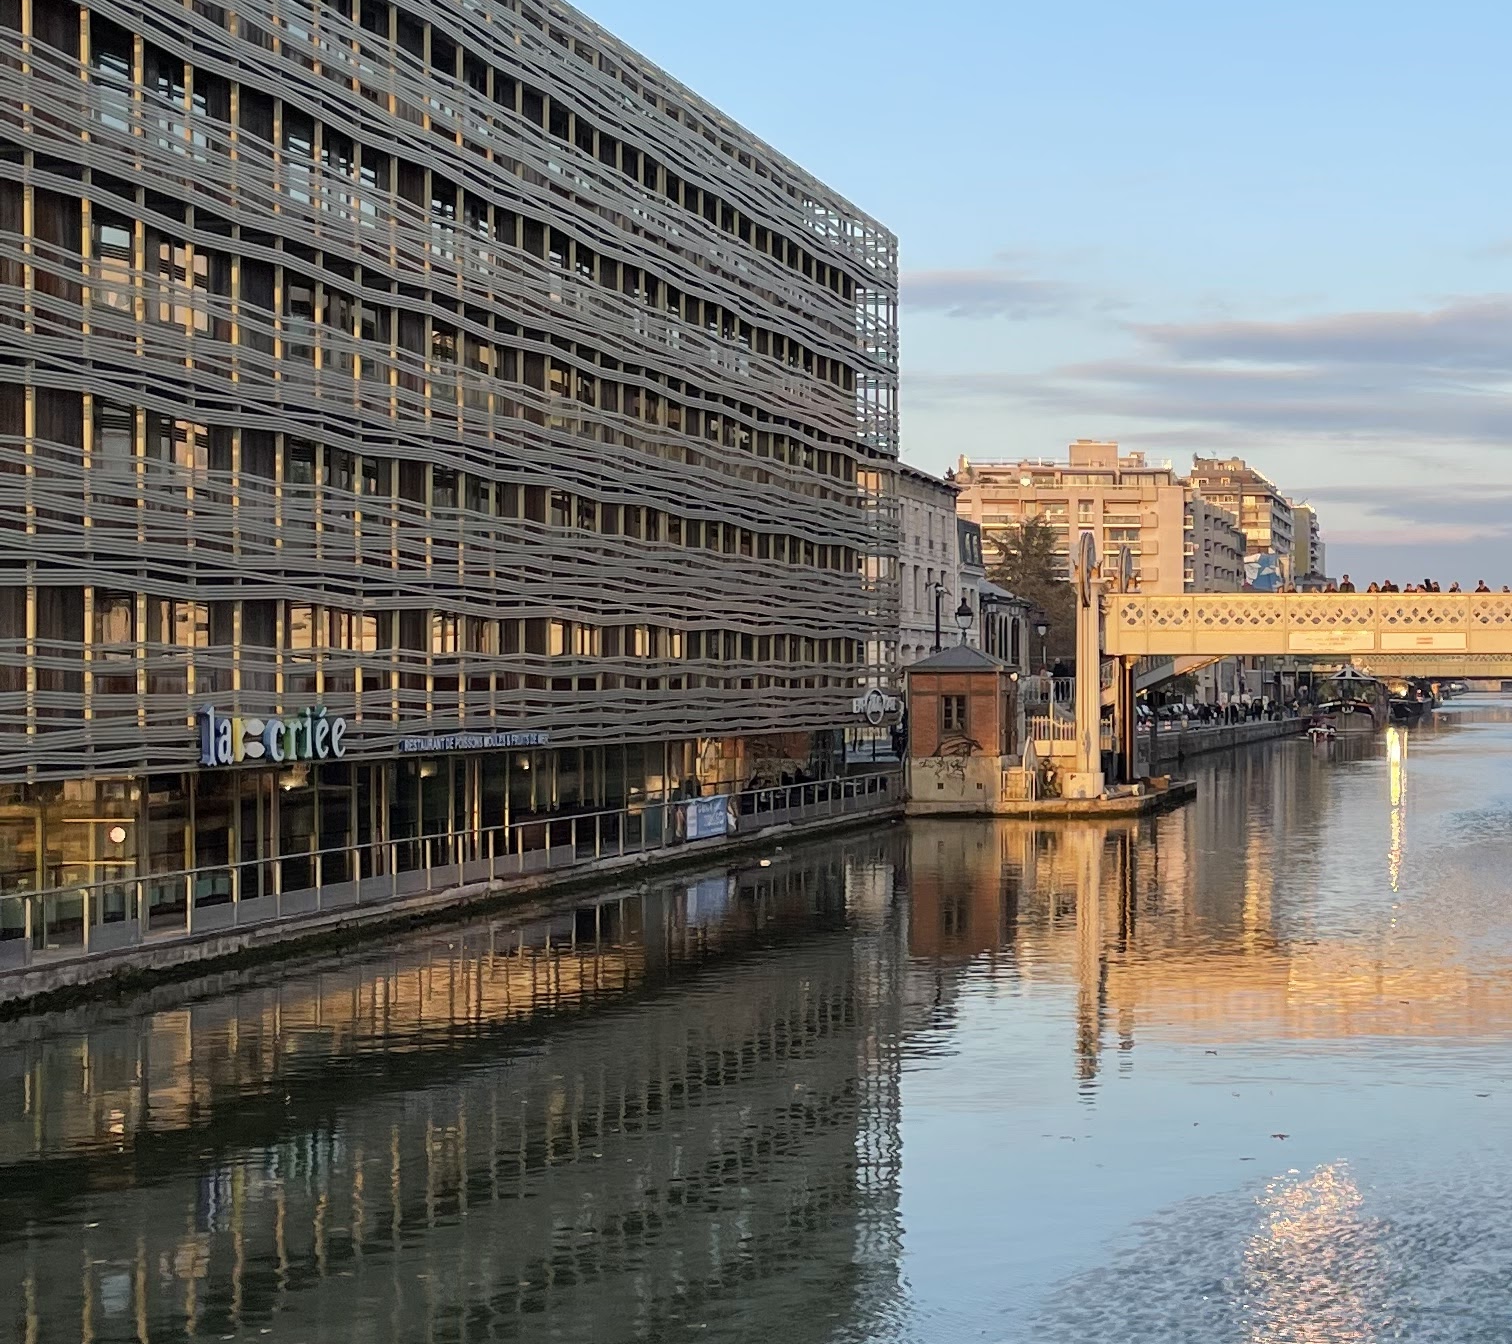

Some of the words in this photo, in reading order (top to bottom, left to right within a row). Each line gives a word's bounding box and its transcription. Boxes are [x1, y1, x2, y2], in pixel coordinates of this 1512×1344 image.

[199, 704, 233, 767] la
[263, 705, 347, 762] criée
[404, 738, 445, 752] RESTAURANT
